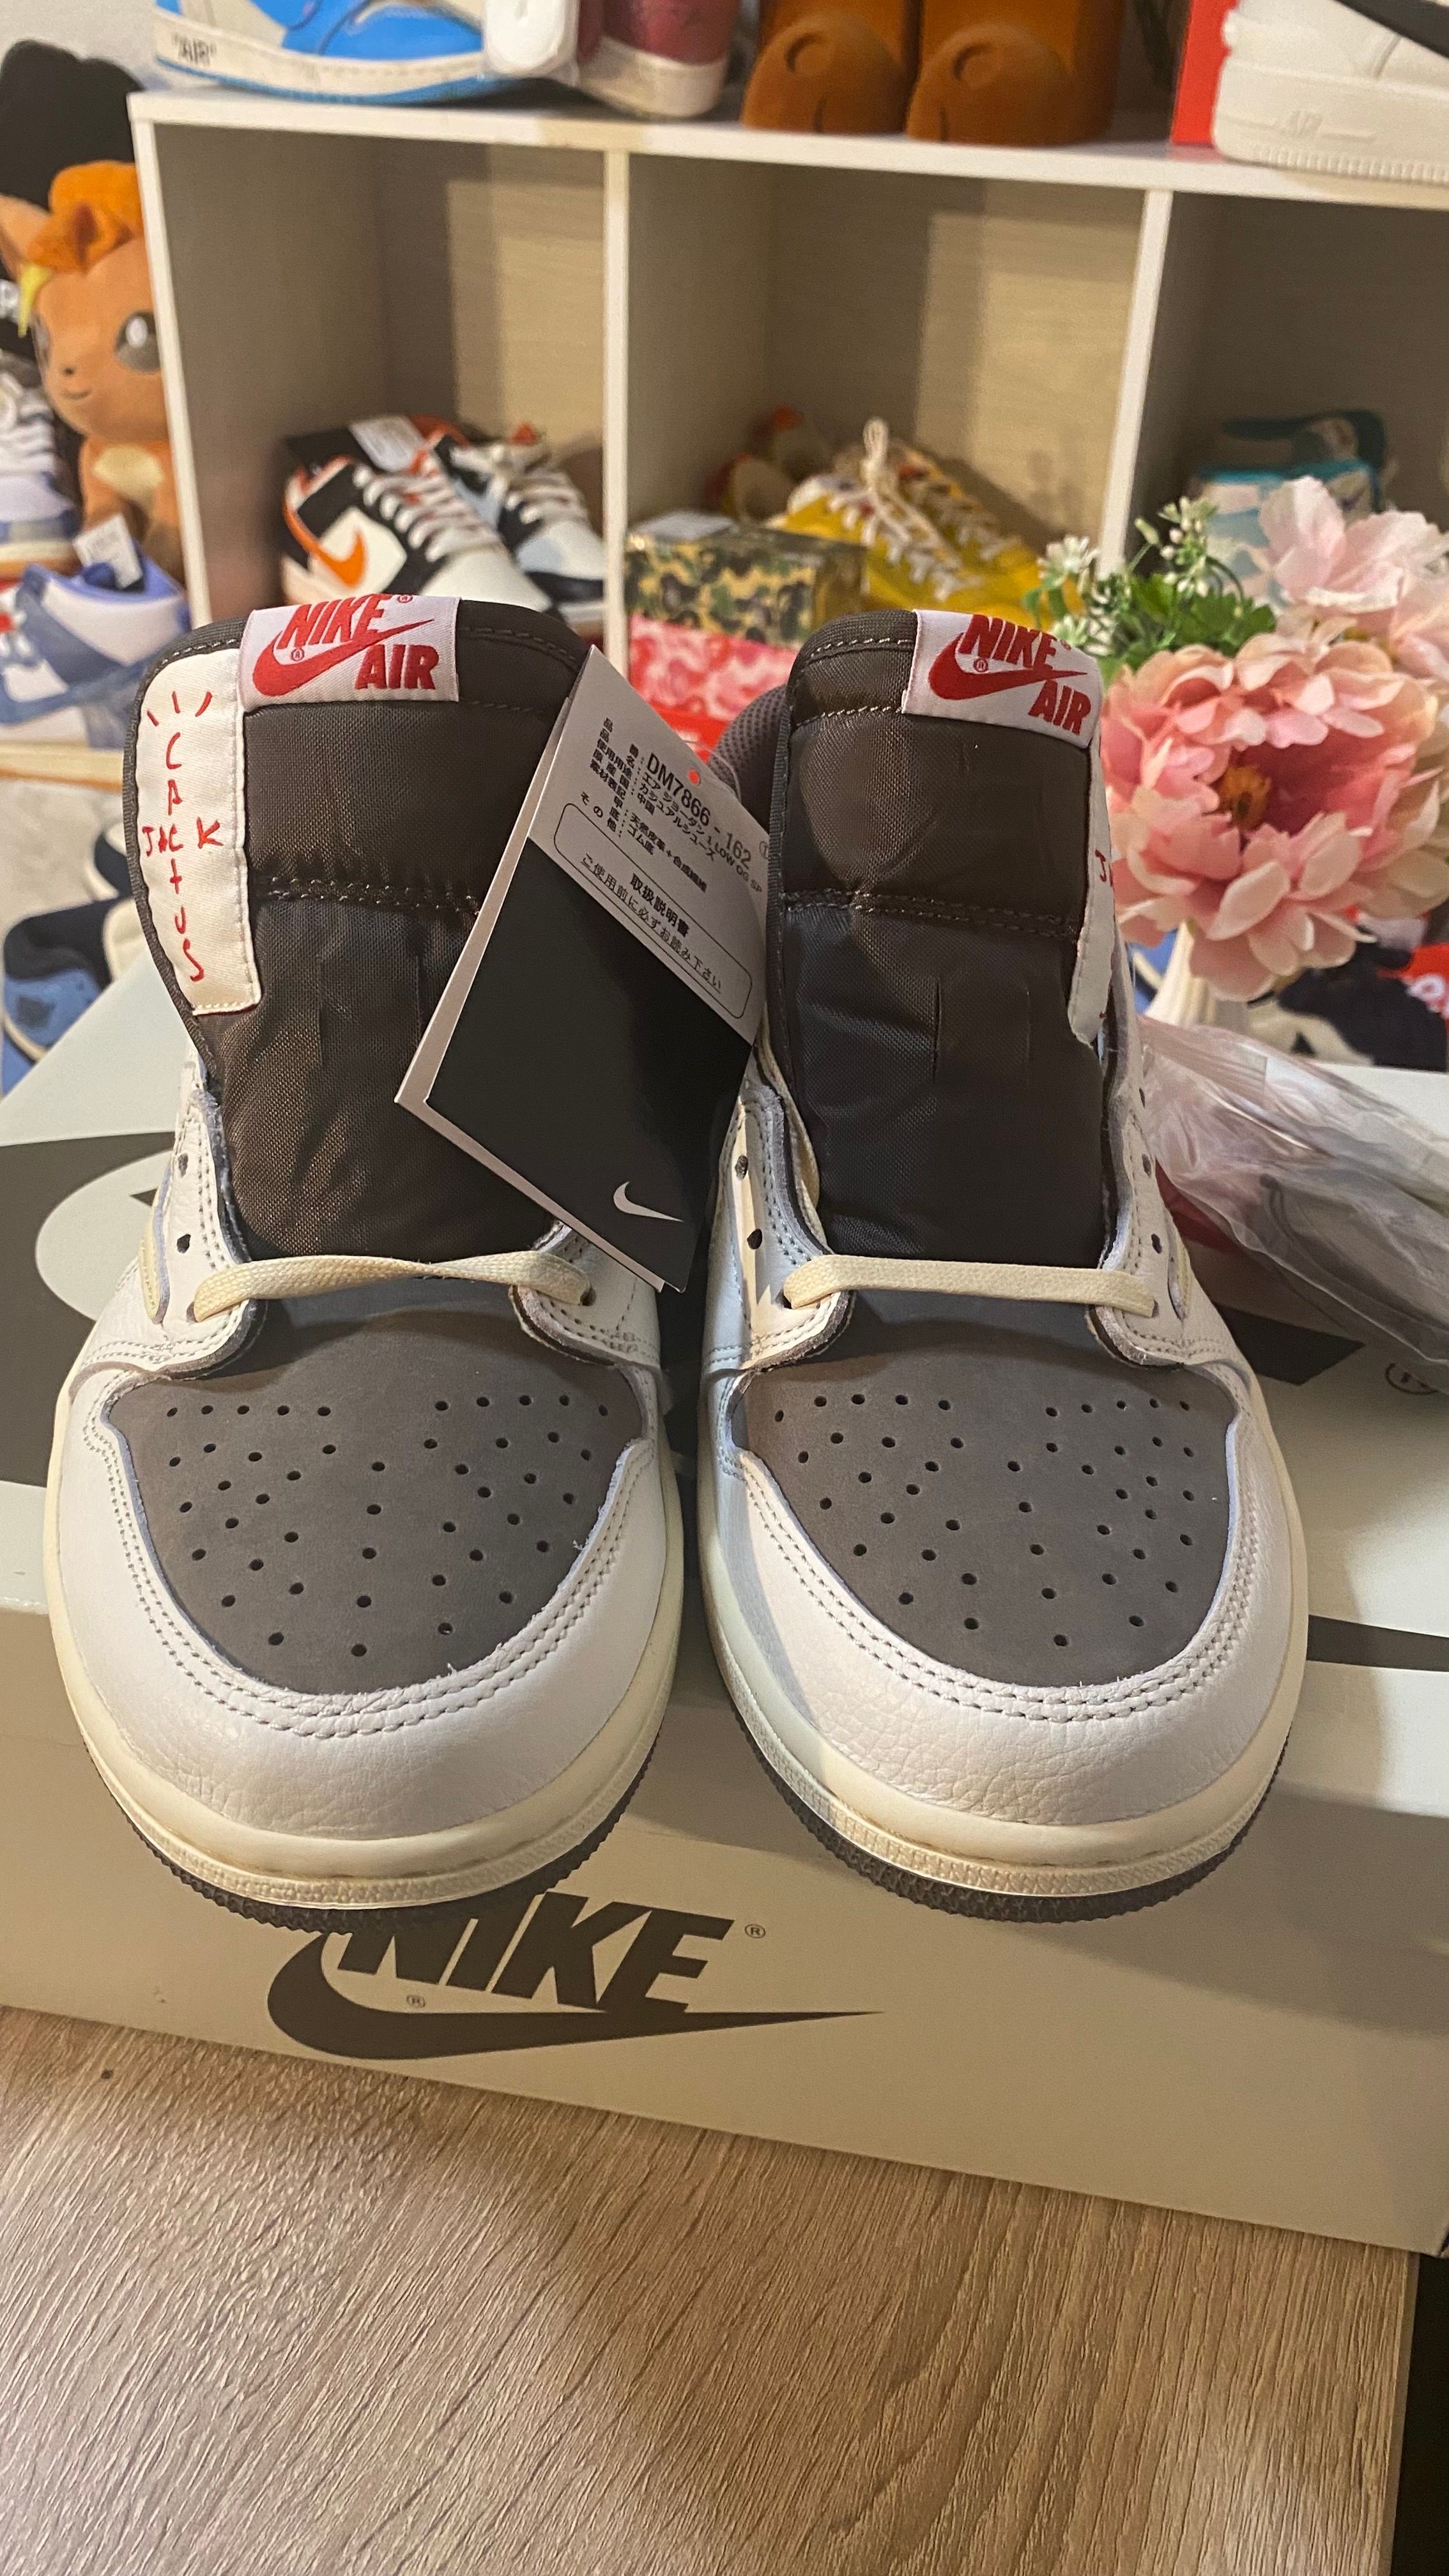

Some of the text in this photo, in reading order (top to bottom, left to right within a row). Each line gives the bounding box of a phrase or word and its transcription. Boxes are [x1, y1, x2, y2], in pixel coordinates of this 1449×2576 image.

[275, 594, 391, 650] NIKE
[958, 614, 1057, 670] NIKE
[354, 644, 439, 689] AIR
[1028, 679, 1091, 735] AIR
[648, 753, 711, 825] DM7866
[728, 832, 753, 870] 162
[582, 854, 722, 988] ご使用前に必ずお読み下さい
[629, 873, 690, 937] 取扱説明書
